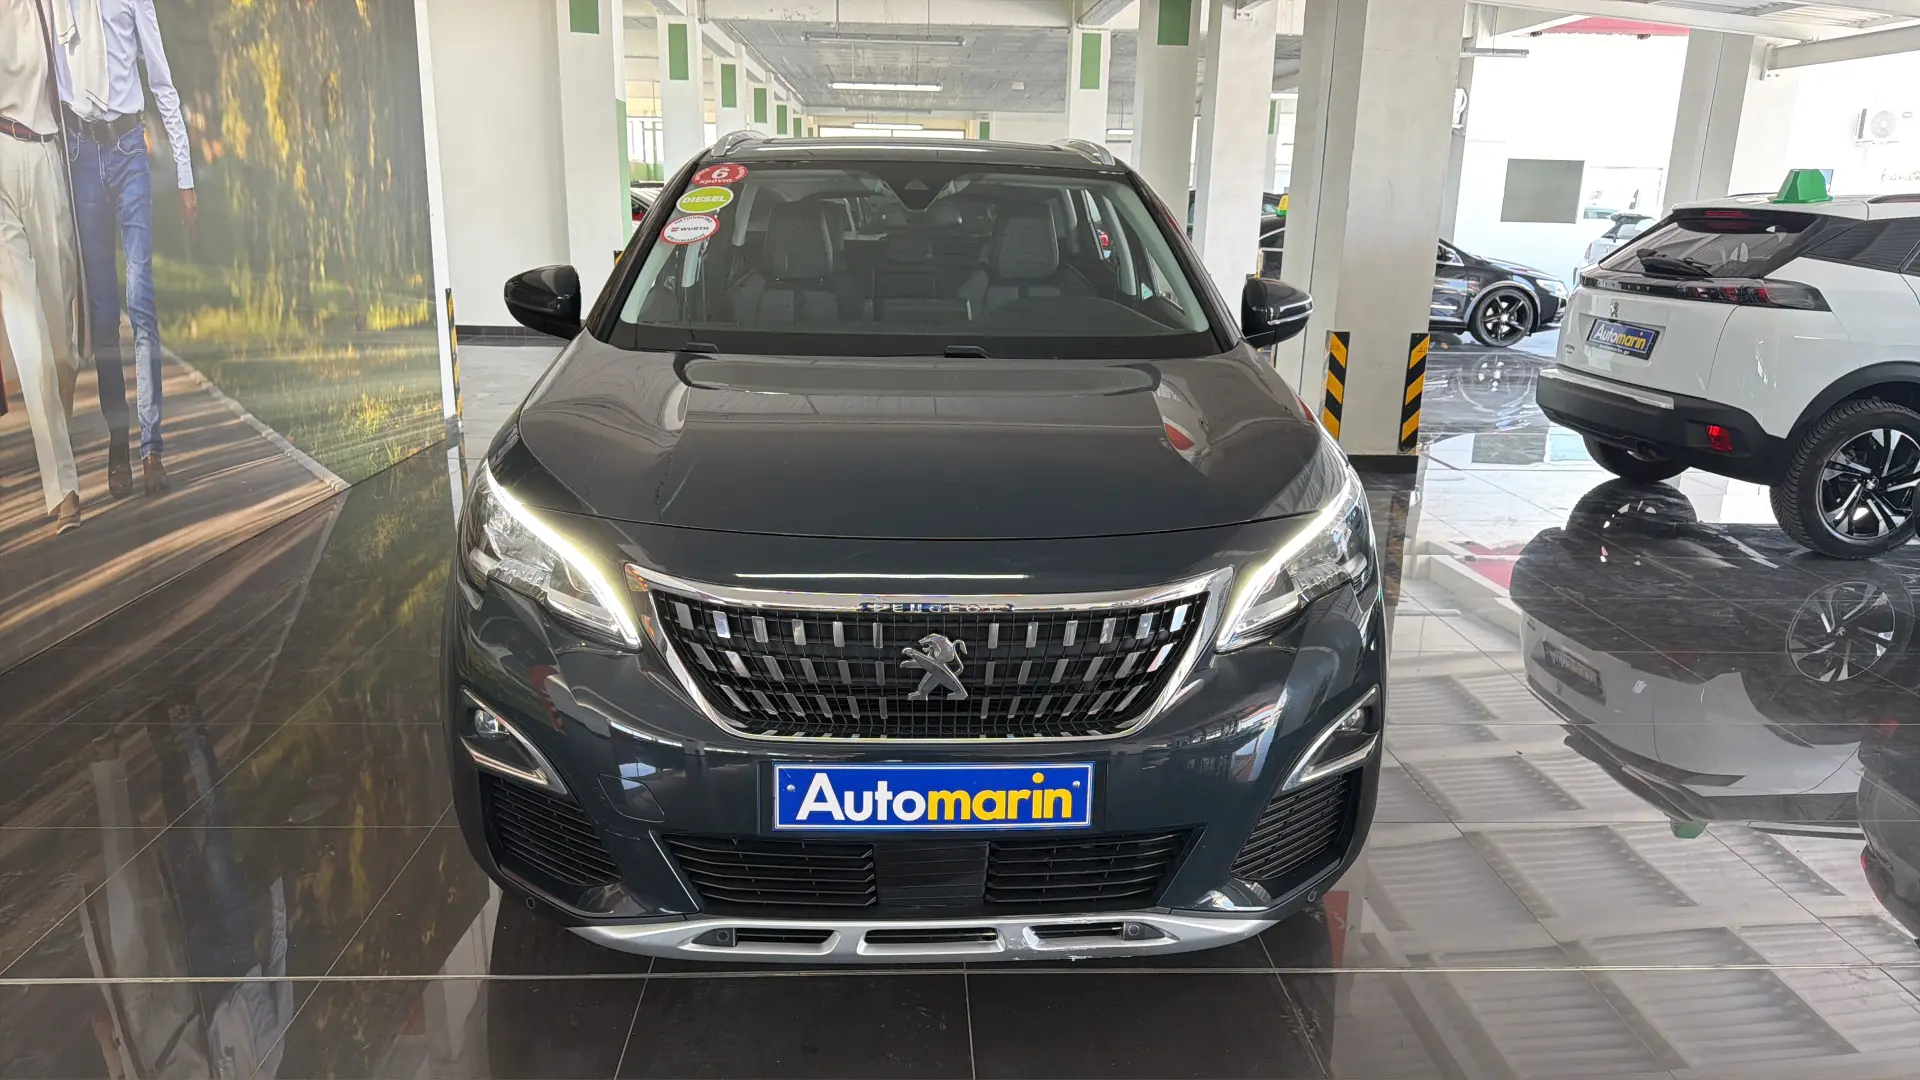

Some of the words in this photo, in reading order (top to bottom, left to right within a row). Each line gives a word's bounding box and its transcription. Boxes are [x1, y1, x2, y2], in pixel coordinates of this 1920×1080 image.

[711, 168, 730, 179] 6
[681, 195, 726, 204] DIESEL
[1594, 324, 1647, 350] Automarin
[873, 603, 997, 613] PEUGEOT
[796, 772, 1072, 822] Automarin
